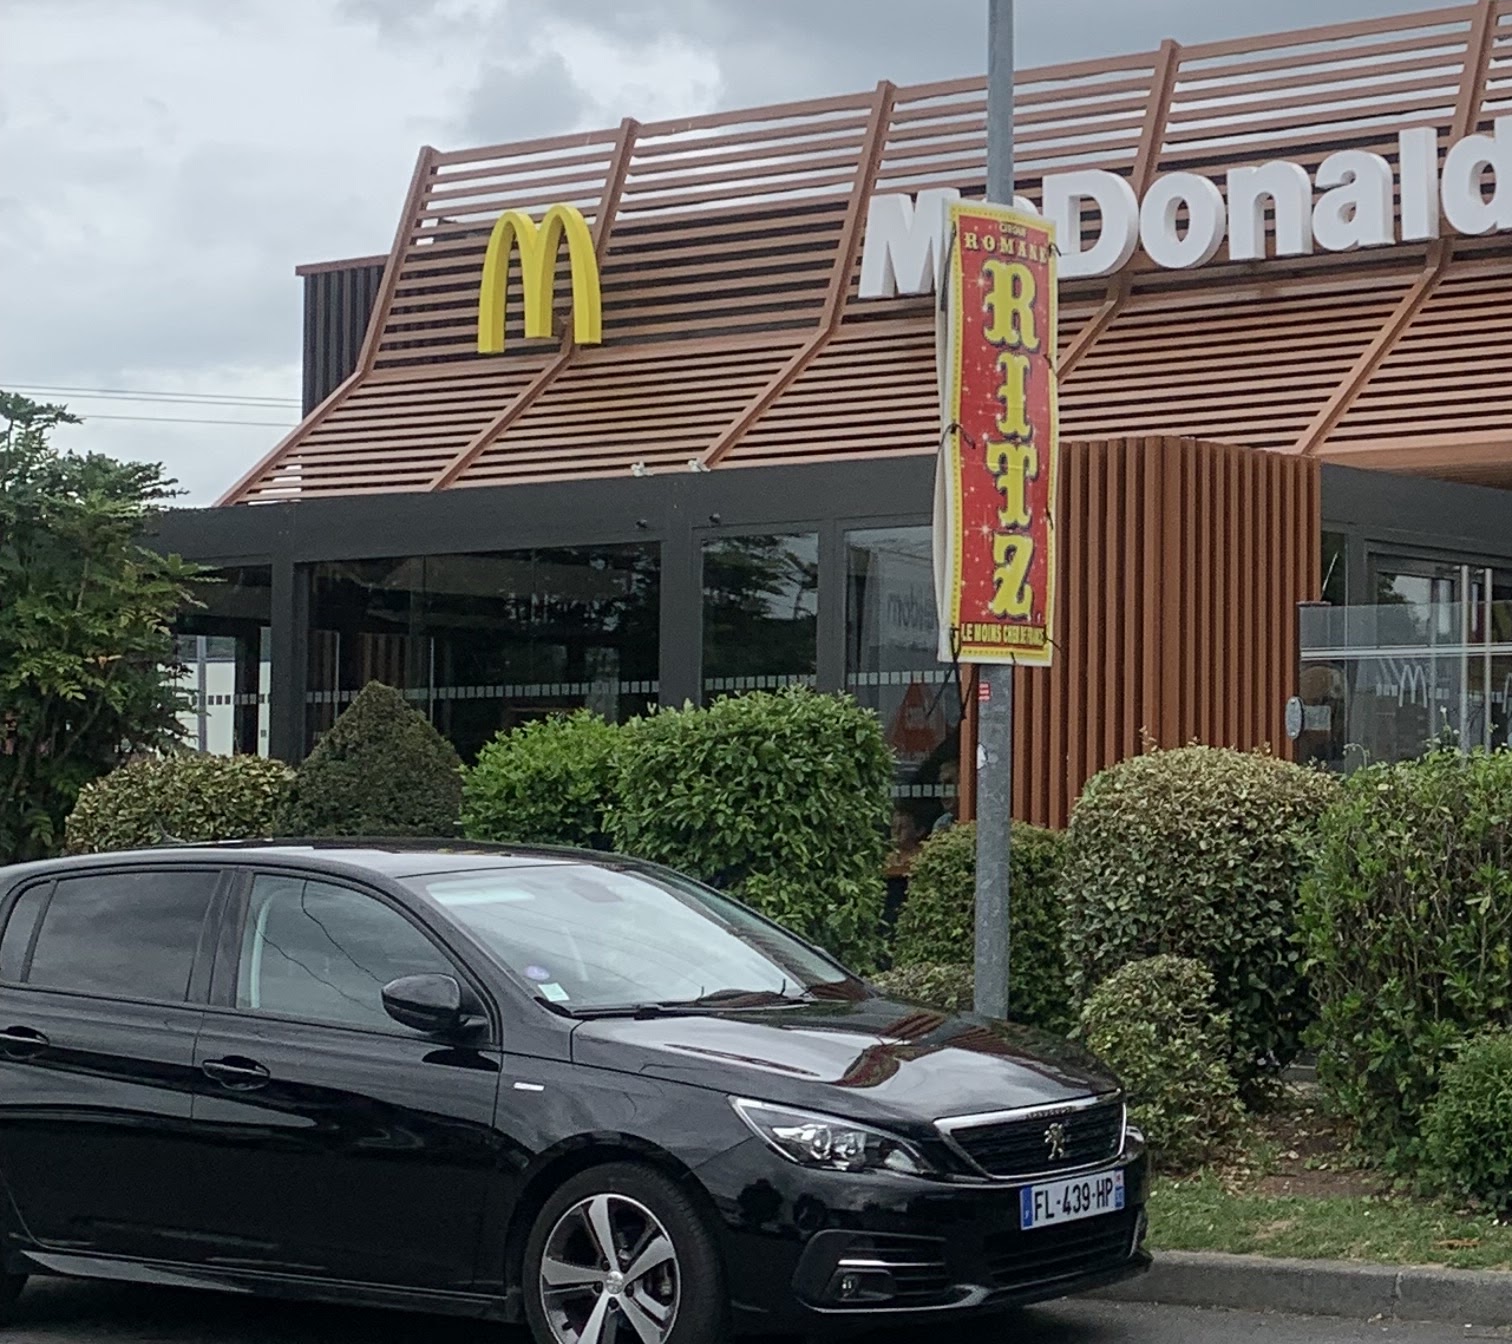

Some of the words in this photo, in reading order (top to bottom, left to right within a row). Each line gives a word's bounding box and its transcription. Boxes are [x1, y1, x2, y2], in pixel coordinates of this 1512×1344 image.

[981, 257, 1040, 621] RITZ
[961, 623, 973, 642] LE
[1034, 1177, 1114, 1221] FL-439-HP
